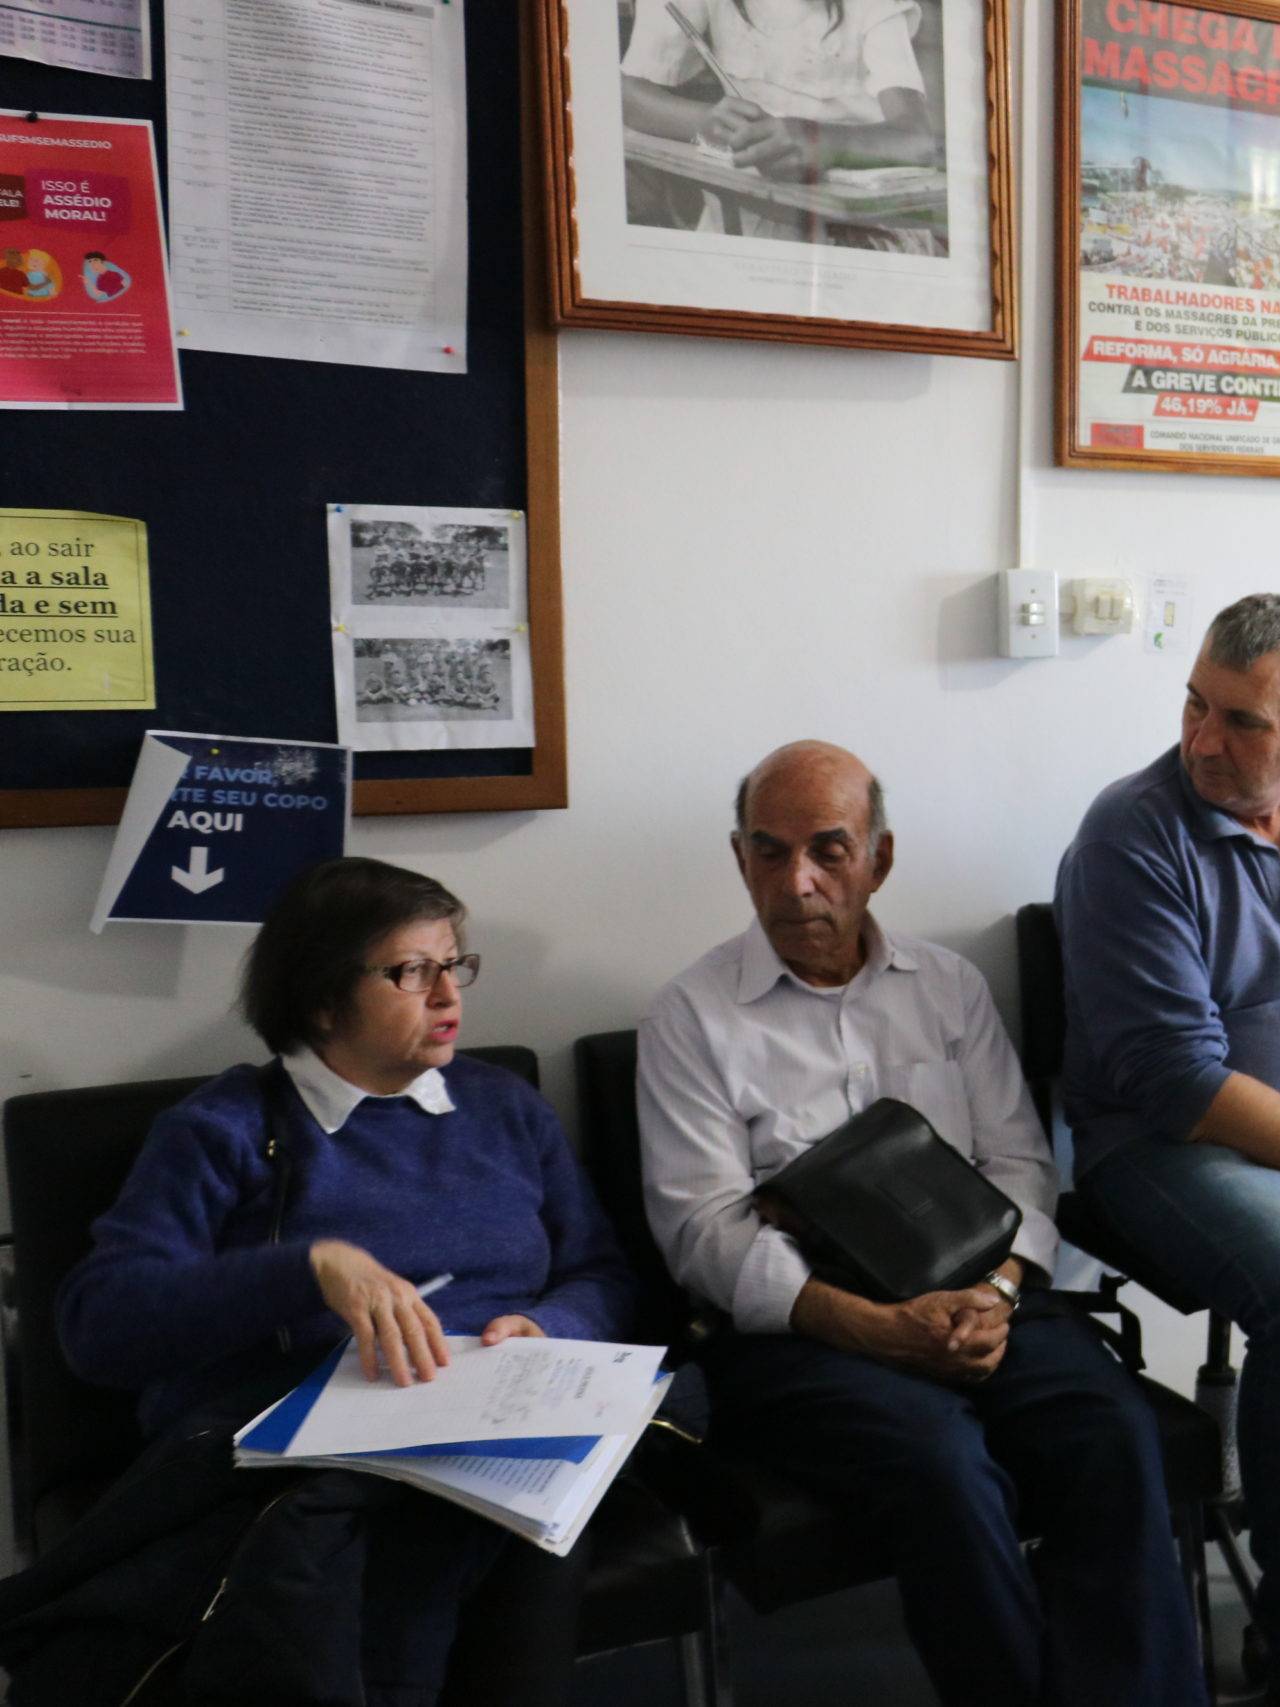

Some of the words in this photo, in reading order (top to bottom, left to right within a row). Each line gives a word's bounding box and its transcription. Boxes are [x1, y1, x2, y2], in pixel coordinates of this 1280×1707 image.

[1106, 0, 1259, 54] CHEGA
[41, 180, 76, 192] ISSO
[80, 180, 90, 193] É
[43, 194, 112, 208] ASSÉDIO
[44, 208, 106, 222] MORAL!
[1105, 283, 1256, 313] TRABALHADORES
[1088, 301, 1141, 317] CONTRA
[1144, 306, 1161, 318] OS
[1165, 308, 1239, 326] MASSACRES
[1242, 315, 1258, 327] DA
[1134, 321, 1142, 331] E
[1146, 322, 1170, 334] DOS
[1174, 324, 1232, 339] SERVIÇOS
[1092, 341, 1178, 363] REFORMA,
[1181, 345, 1204, 363] SÓ
[1207, 347, 1280, 369] AGRÁRIA.
[1130, 369, 1148, 388] A
[1150, 370, 1218, 393] GREVE
[1160, 395, 1223, 414] 46,19%
[1225, 397, 1254, 416] JÁ.
[1150, 430, 1188, 440] COMANDO
[10, 541, 40, 556] ao
[48, 537, 95, 557] sair
[26, 570, 42, 586] a
[51, 566, 109, 587] sala
[35, 599, 50, 614] e
[59, 599, 118, 615] sem
[94, 628, 136, 643] sua
[213, 789, 257, 806] SEU
[263, 793, 328, 810] COPO
[167, 810, 244, 834] AQUI
